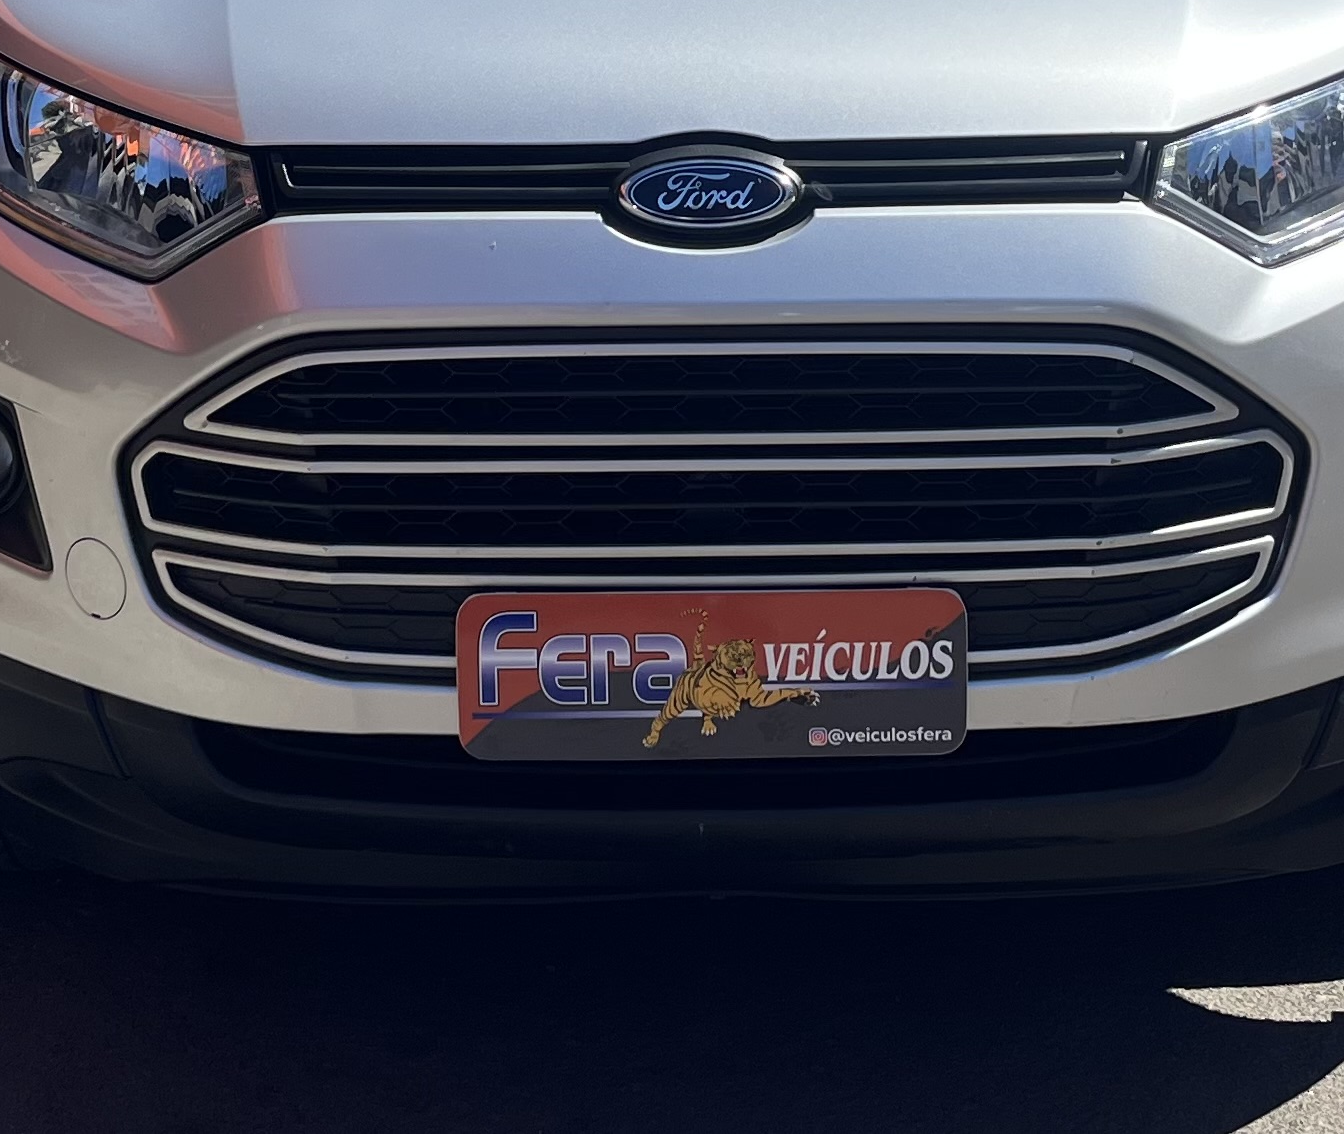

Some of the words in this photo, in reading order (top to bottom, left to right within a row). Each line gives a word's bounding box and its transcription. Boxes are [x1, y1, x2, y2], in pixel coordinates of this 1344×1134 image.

[658, 172, 753, 211] Ford
[479, 611, 687, 706] Fera
[763, 629, 954, 682] VEÍCULOS
[827, 726, 952, 744] @veiculosfera
